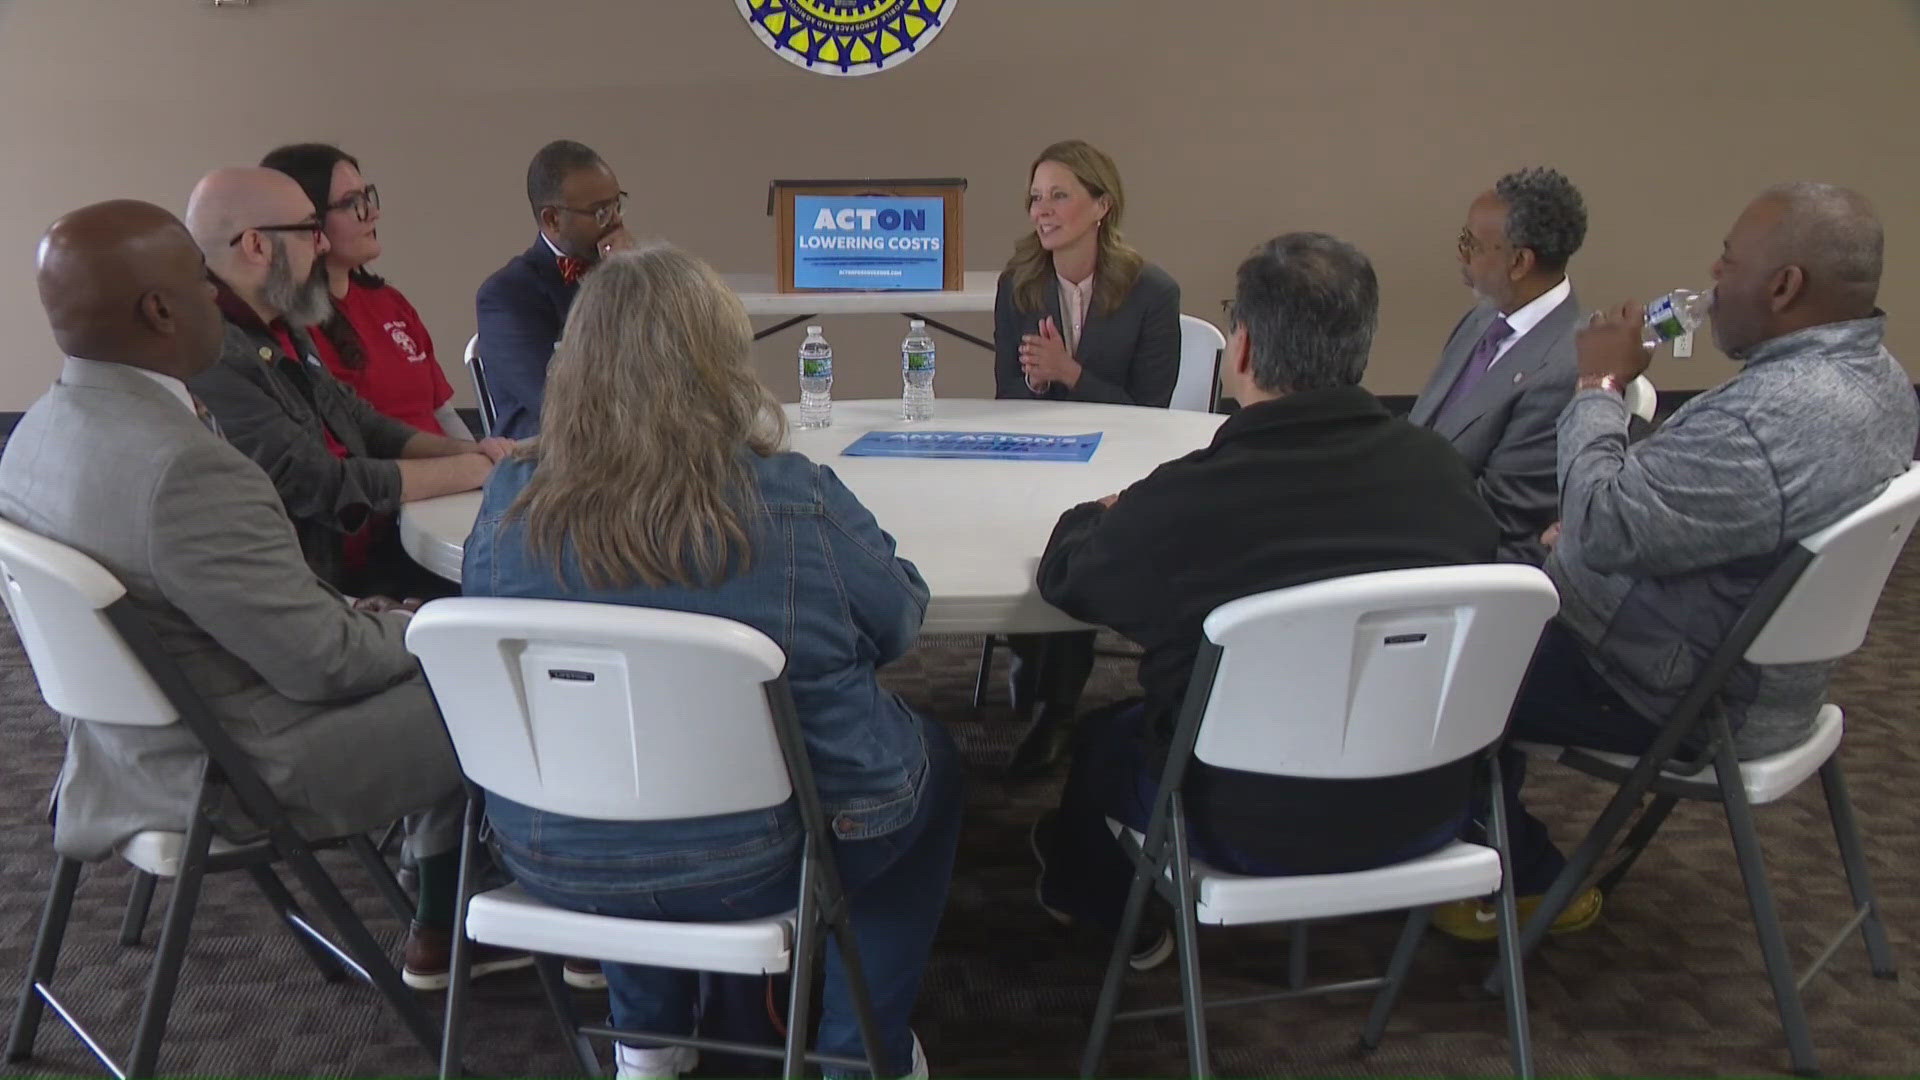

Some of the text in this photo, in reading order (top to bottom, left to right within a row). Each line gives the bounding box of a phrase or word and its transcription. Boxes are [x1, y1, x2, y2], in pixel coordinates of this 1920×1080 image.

[816, 20, 834, 30] AND
[835, 19, 878, 31] AEROSPACE
[799, 235, 940, 250] LOWERING COSTS
